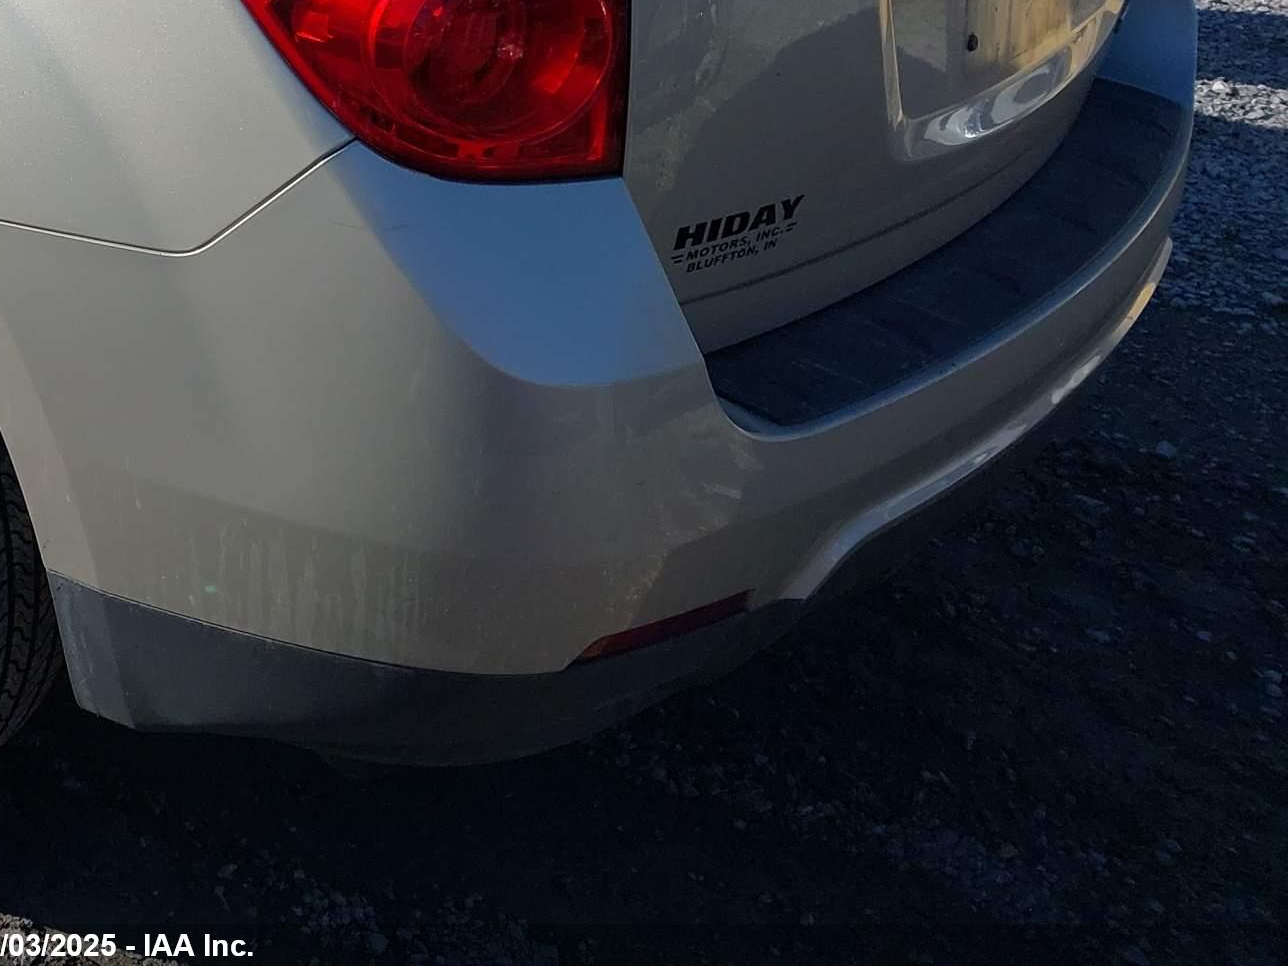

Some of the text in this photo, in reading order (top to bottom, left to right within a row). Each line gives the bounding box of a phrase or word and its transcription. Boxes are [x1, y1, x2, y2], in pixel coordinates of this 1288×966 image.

[673, 194, 806, 251] HIDAY
[686, 224, 784, 261] MOTORS, INC.
[686, 238, 779, 274] BLUFFTON, IN
